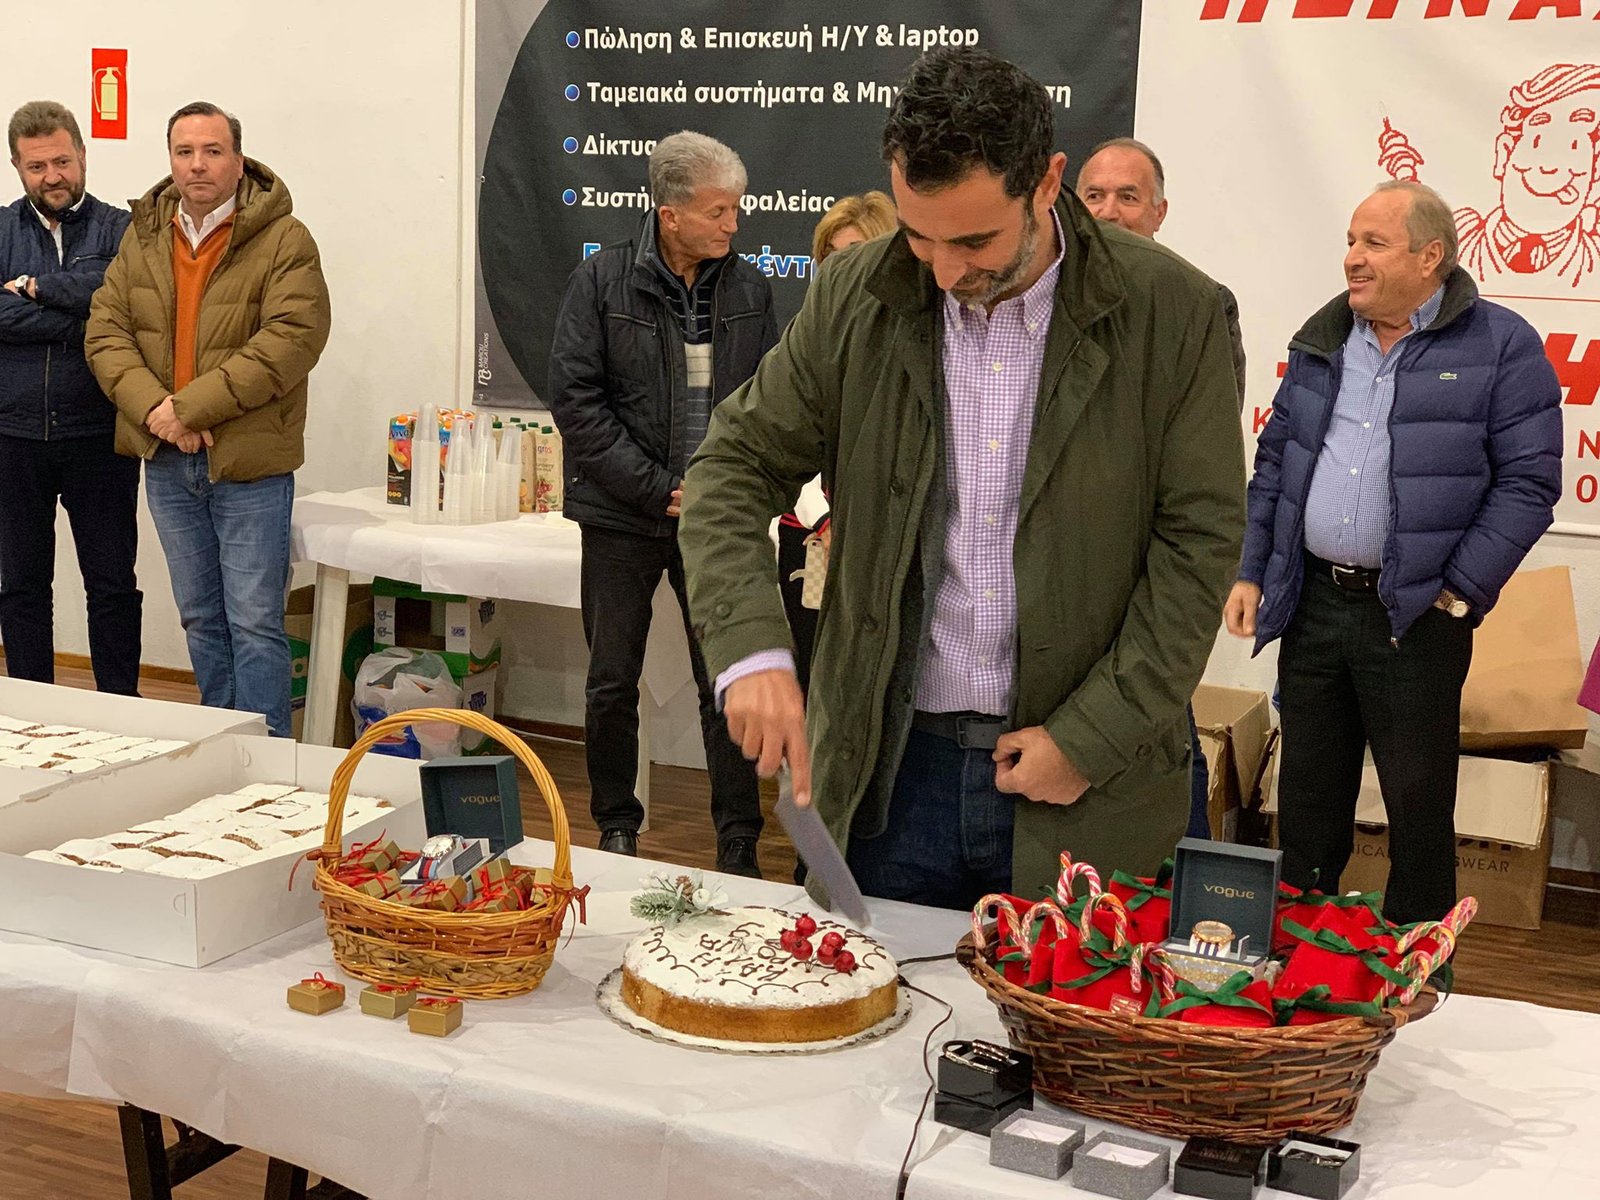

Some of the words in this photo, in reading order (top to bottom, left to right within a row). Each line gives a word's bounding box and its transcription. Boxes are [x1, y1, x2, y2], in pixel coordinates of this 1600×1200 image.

[584, 26, 672, 54] Πώληση
[679, 27, 698, 49] &
[704, 24, 813, 53] Επισκευή
[875, 25, 894, 47] &
[899, 23, 980, 52] laptop
[586, 79, 687, 108] Ταμειακά
[694, 79, 824, 109] συστήματα
[832, 81, 851, 104] &
[739, 189, 836, 216] φαλείας
[460, 794, 501, 805] vogue
[1203, 883, 1255, 900] vogue
